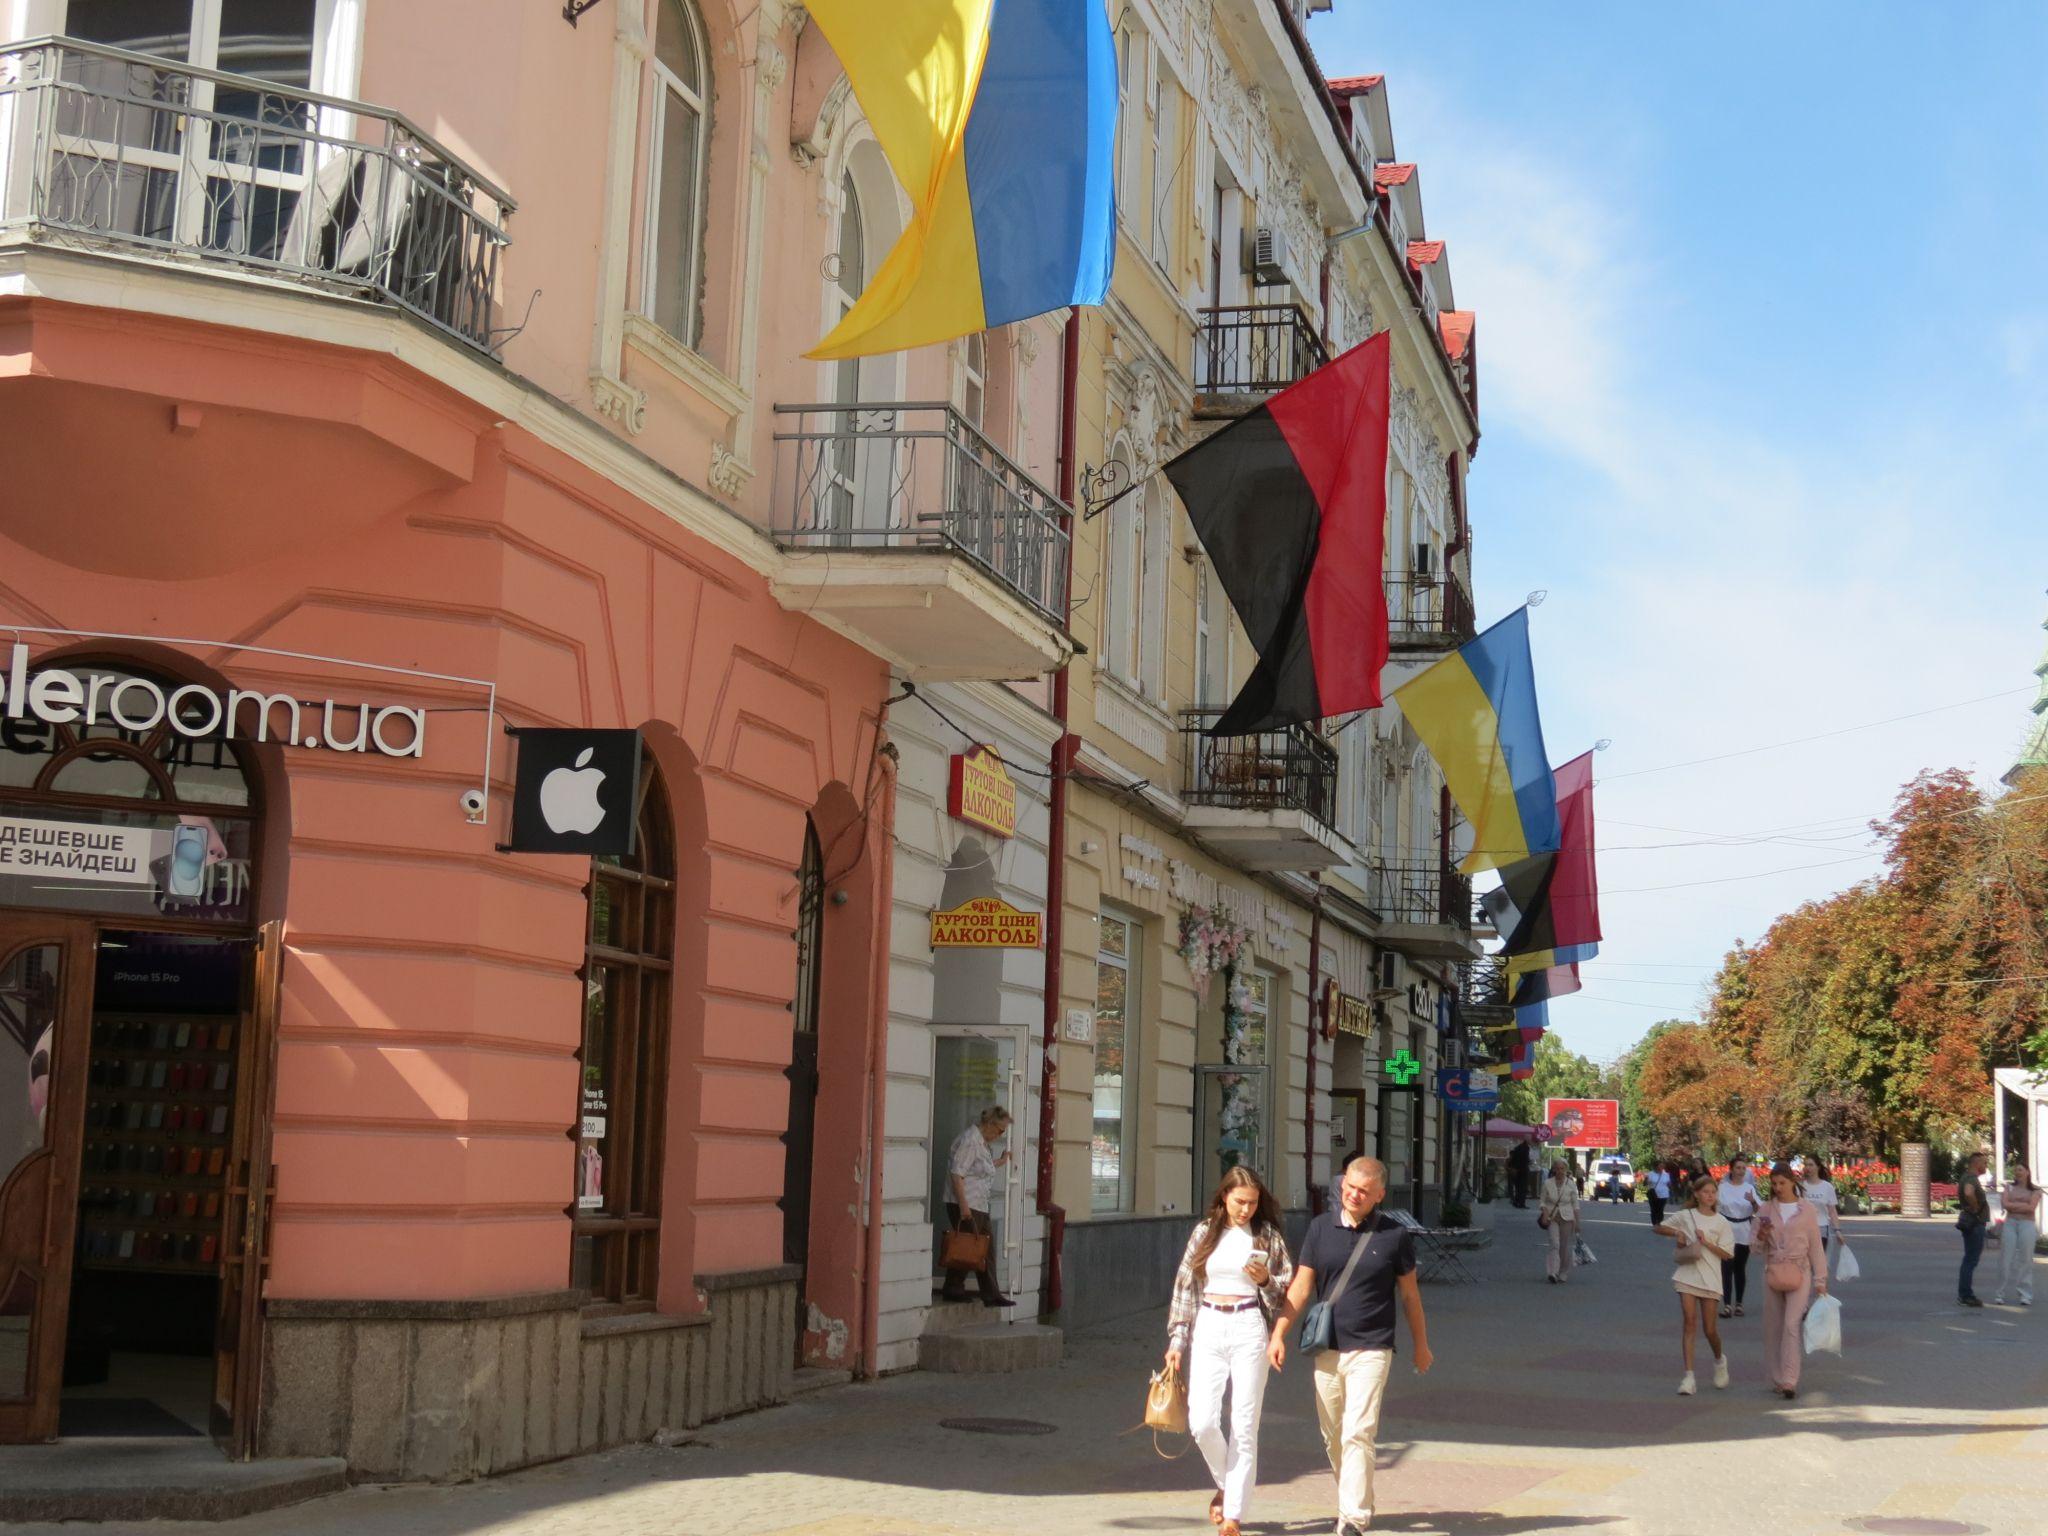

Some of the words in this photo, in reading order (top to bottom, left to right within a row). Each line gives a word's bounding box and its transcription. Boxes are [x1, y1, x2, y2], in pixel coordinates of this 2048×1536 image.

[0, 644, 426, 758] leroom.ua
[965, 765, 996, 794] ГУРТОВІ
[997, 780, 1014, 804] ЦІНИ
[963, 787, 1014, 831] АЛКОГОЛЬ
[0, 825, 124, 852] ДЕШЕВШЕ
[19, 848, 137, 874] ЗНАЙДЕШ
[934, 914, 995, 926] ГУРТОВІ
[999, 915, 1037, 928] ЦІНИ
[933, 928, 1037, 944] АЛКОГОЛЬ
[114, 971, 149, 983] iPhone
[151, 972, 160, 982] 15
[162, 972, 181, 983] Pro
